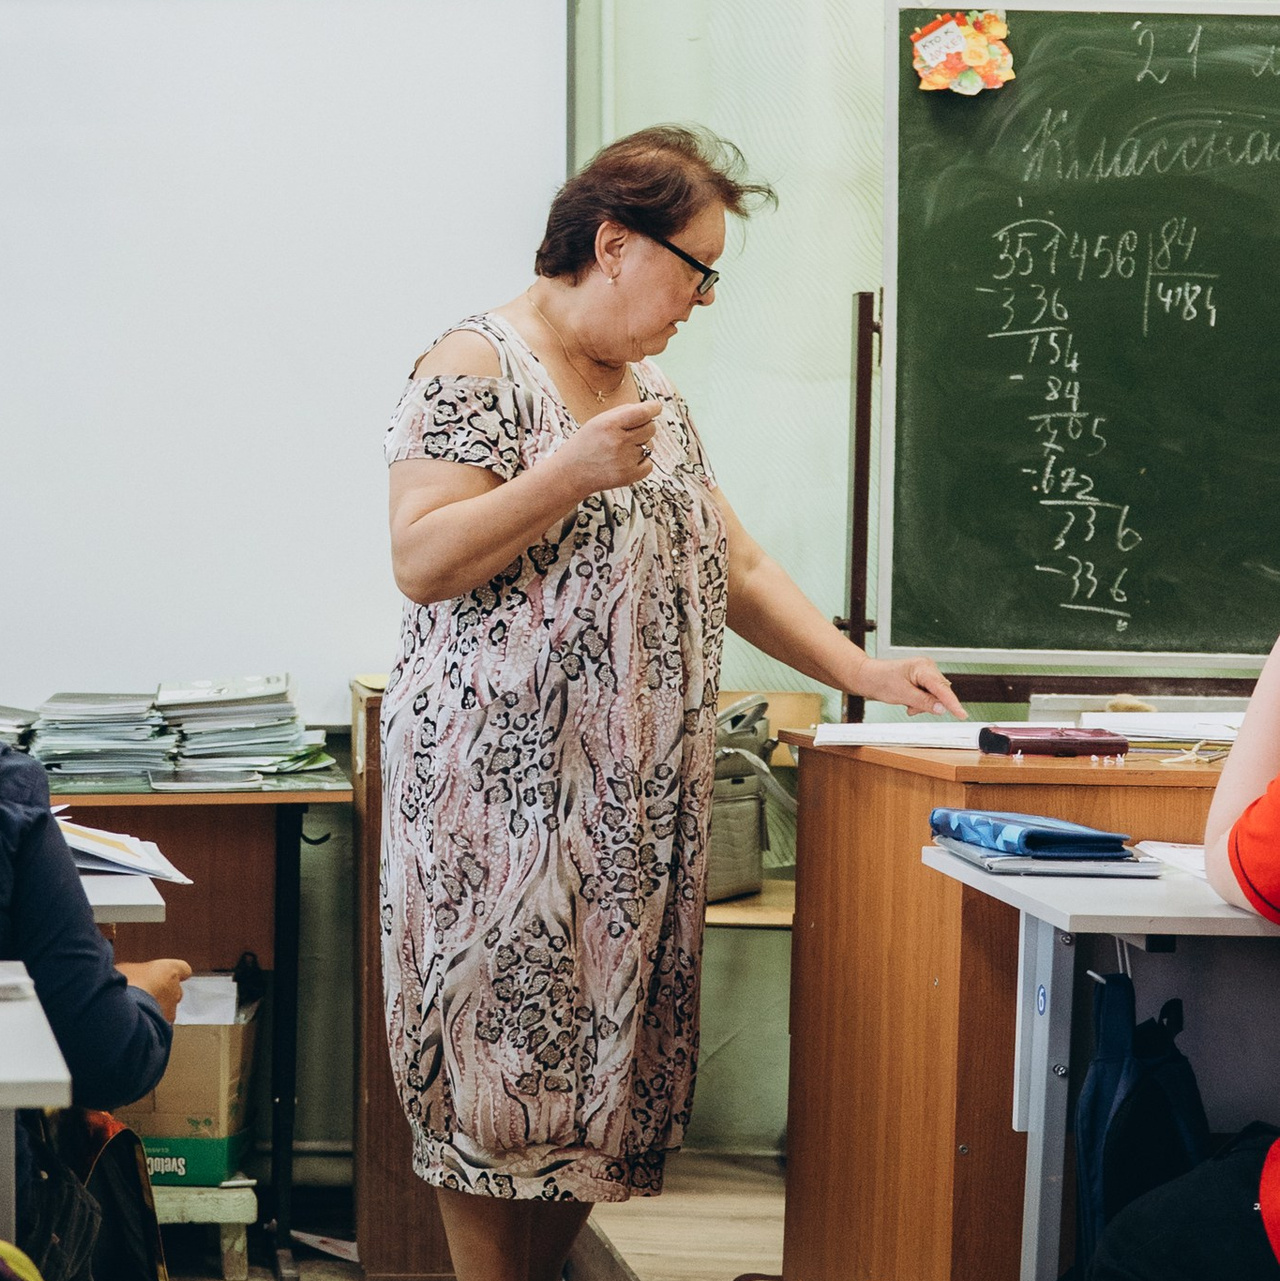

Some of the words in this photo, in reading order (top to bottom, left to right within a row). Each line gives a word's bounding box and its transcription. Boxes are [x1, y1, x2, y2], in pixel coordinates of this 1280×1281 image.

[1155, 216, 1197, 270] 84
[1028, 332, 1081, 373] 154
[1053, 505, 1143, 552] 336
